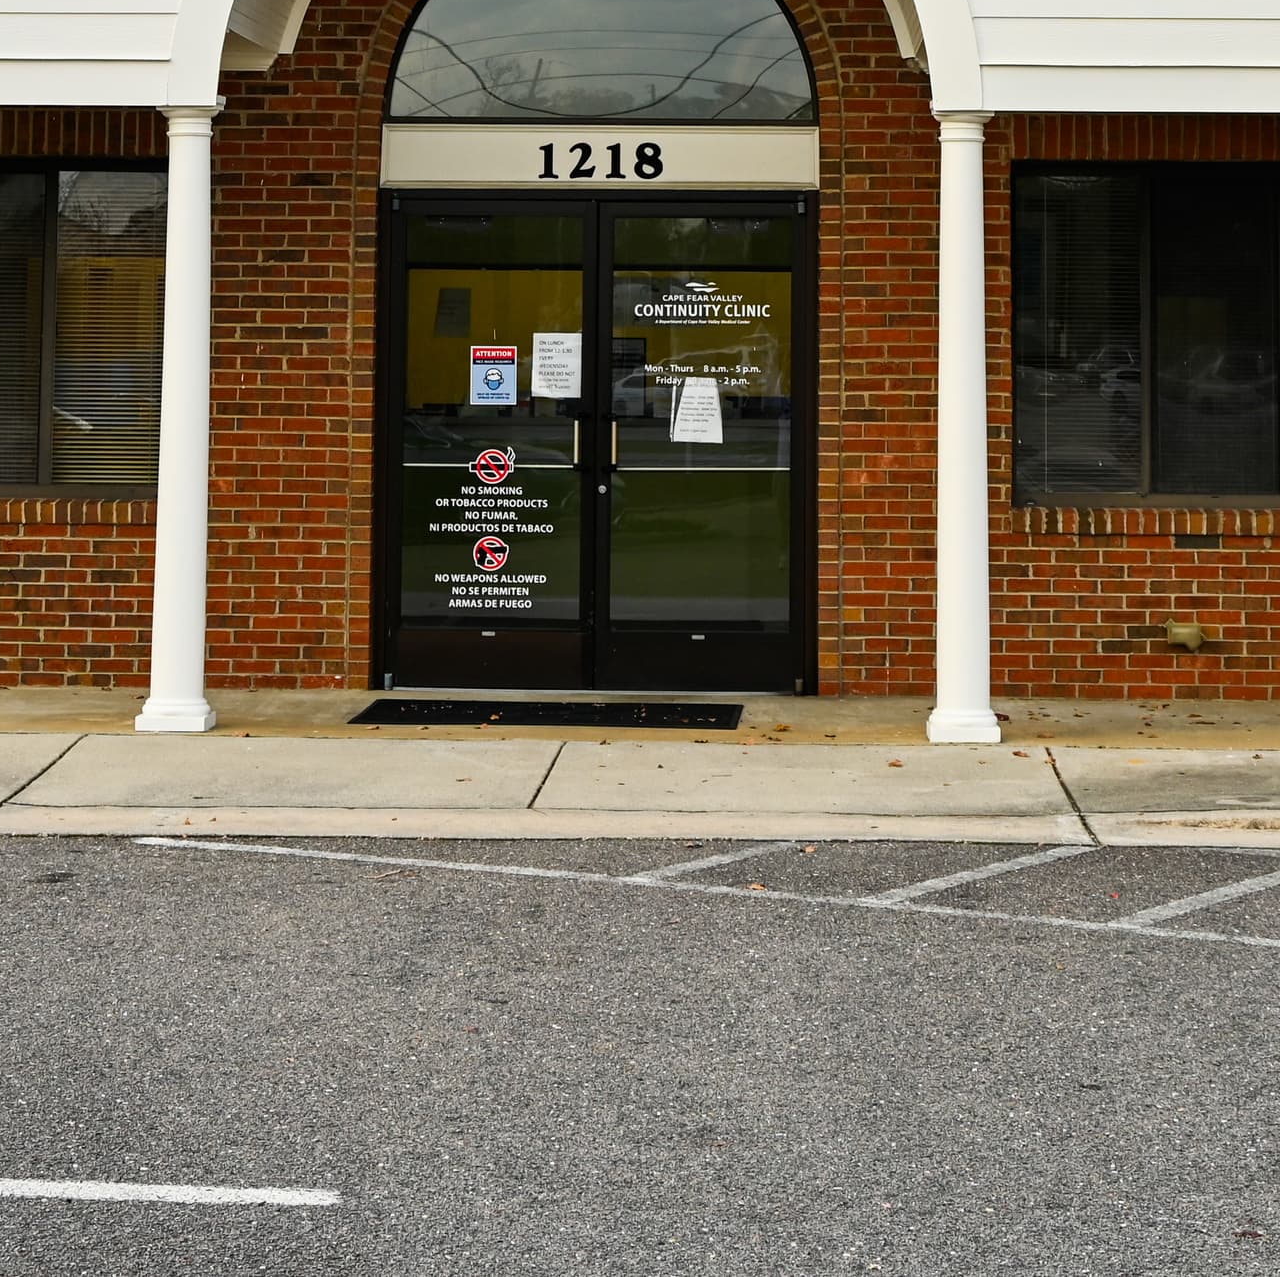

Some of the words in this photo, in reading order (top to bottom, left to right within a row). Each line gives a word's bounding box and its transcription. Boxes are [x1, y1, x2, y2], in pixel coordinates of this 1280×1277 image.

[538, 143, 664, 180] 1218
[662, 294, 684, 302] CAPE
[687, 294, 709, 302] FEAR
[634, 304, 721, 317] CONTINUITY
[724, 304, 771, 317] CLINIC
[644, 364, 663, 373] Mon
[670, 364, 694, 373] Thurs
[703, 364, 709, 373] 8
[735, 365, 741, 373] 5
[742, 366, 761, 375] p.m.
[655, 376, 682, 386] Friday
[724, 377, 729, 385] 2
[731, 378, 750, 387] p.m.
[461, 486, 476, 495] NO
[477, 486, 523, 495] SMOKING
[435, 498, 449, 507] OR
[450, 498, 495, 507] TOBACCO
[497, 499, 548, 508] PRODUCTS
[465, 511, 479, 520] NO
[429, 523, 439, 532] NI
[441, 523, 499, 532] PRODUCTOS
[501, 524, 514, 533] DE
[516, 524, 554, 533] TABACO
[434, 574, 449, 582] NO
[450, 574, 499, 583] WEAPONS
[500, 574, 547, 583] ALLOWED
[451, 587, 466, 595] NO
[468, 587, 479, 595] SE
[481, 587, 529, 596] PERMITEN
[448, 599, 482, 608] ARMAS
[484, 599, 498, 608] DE
[499, 599, 533, 609] FUEGO
